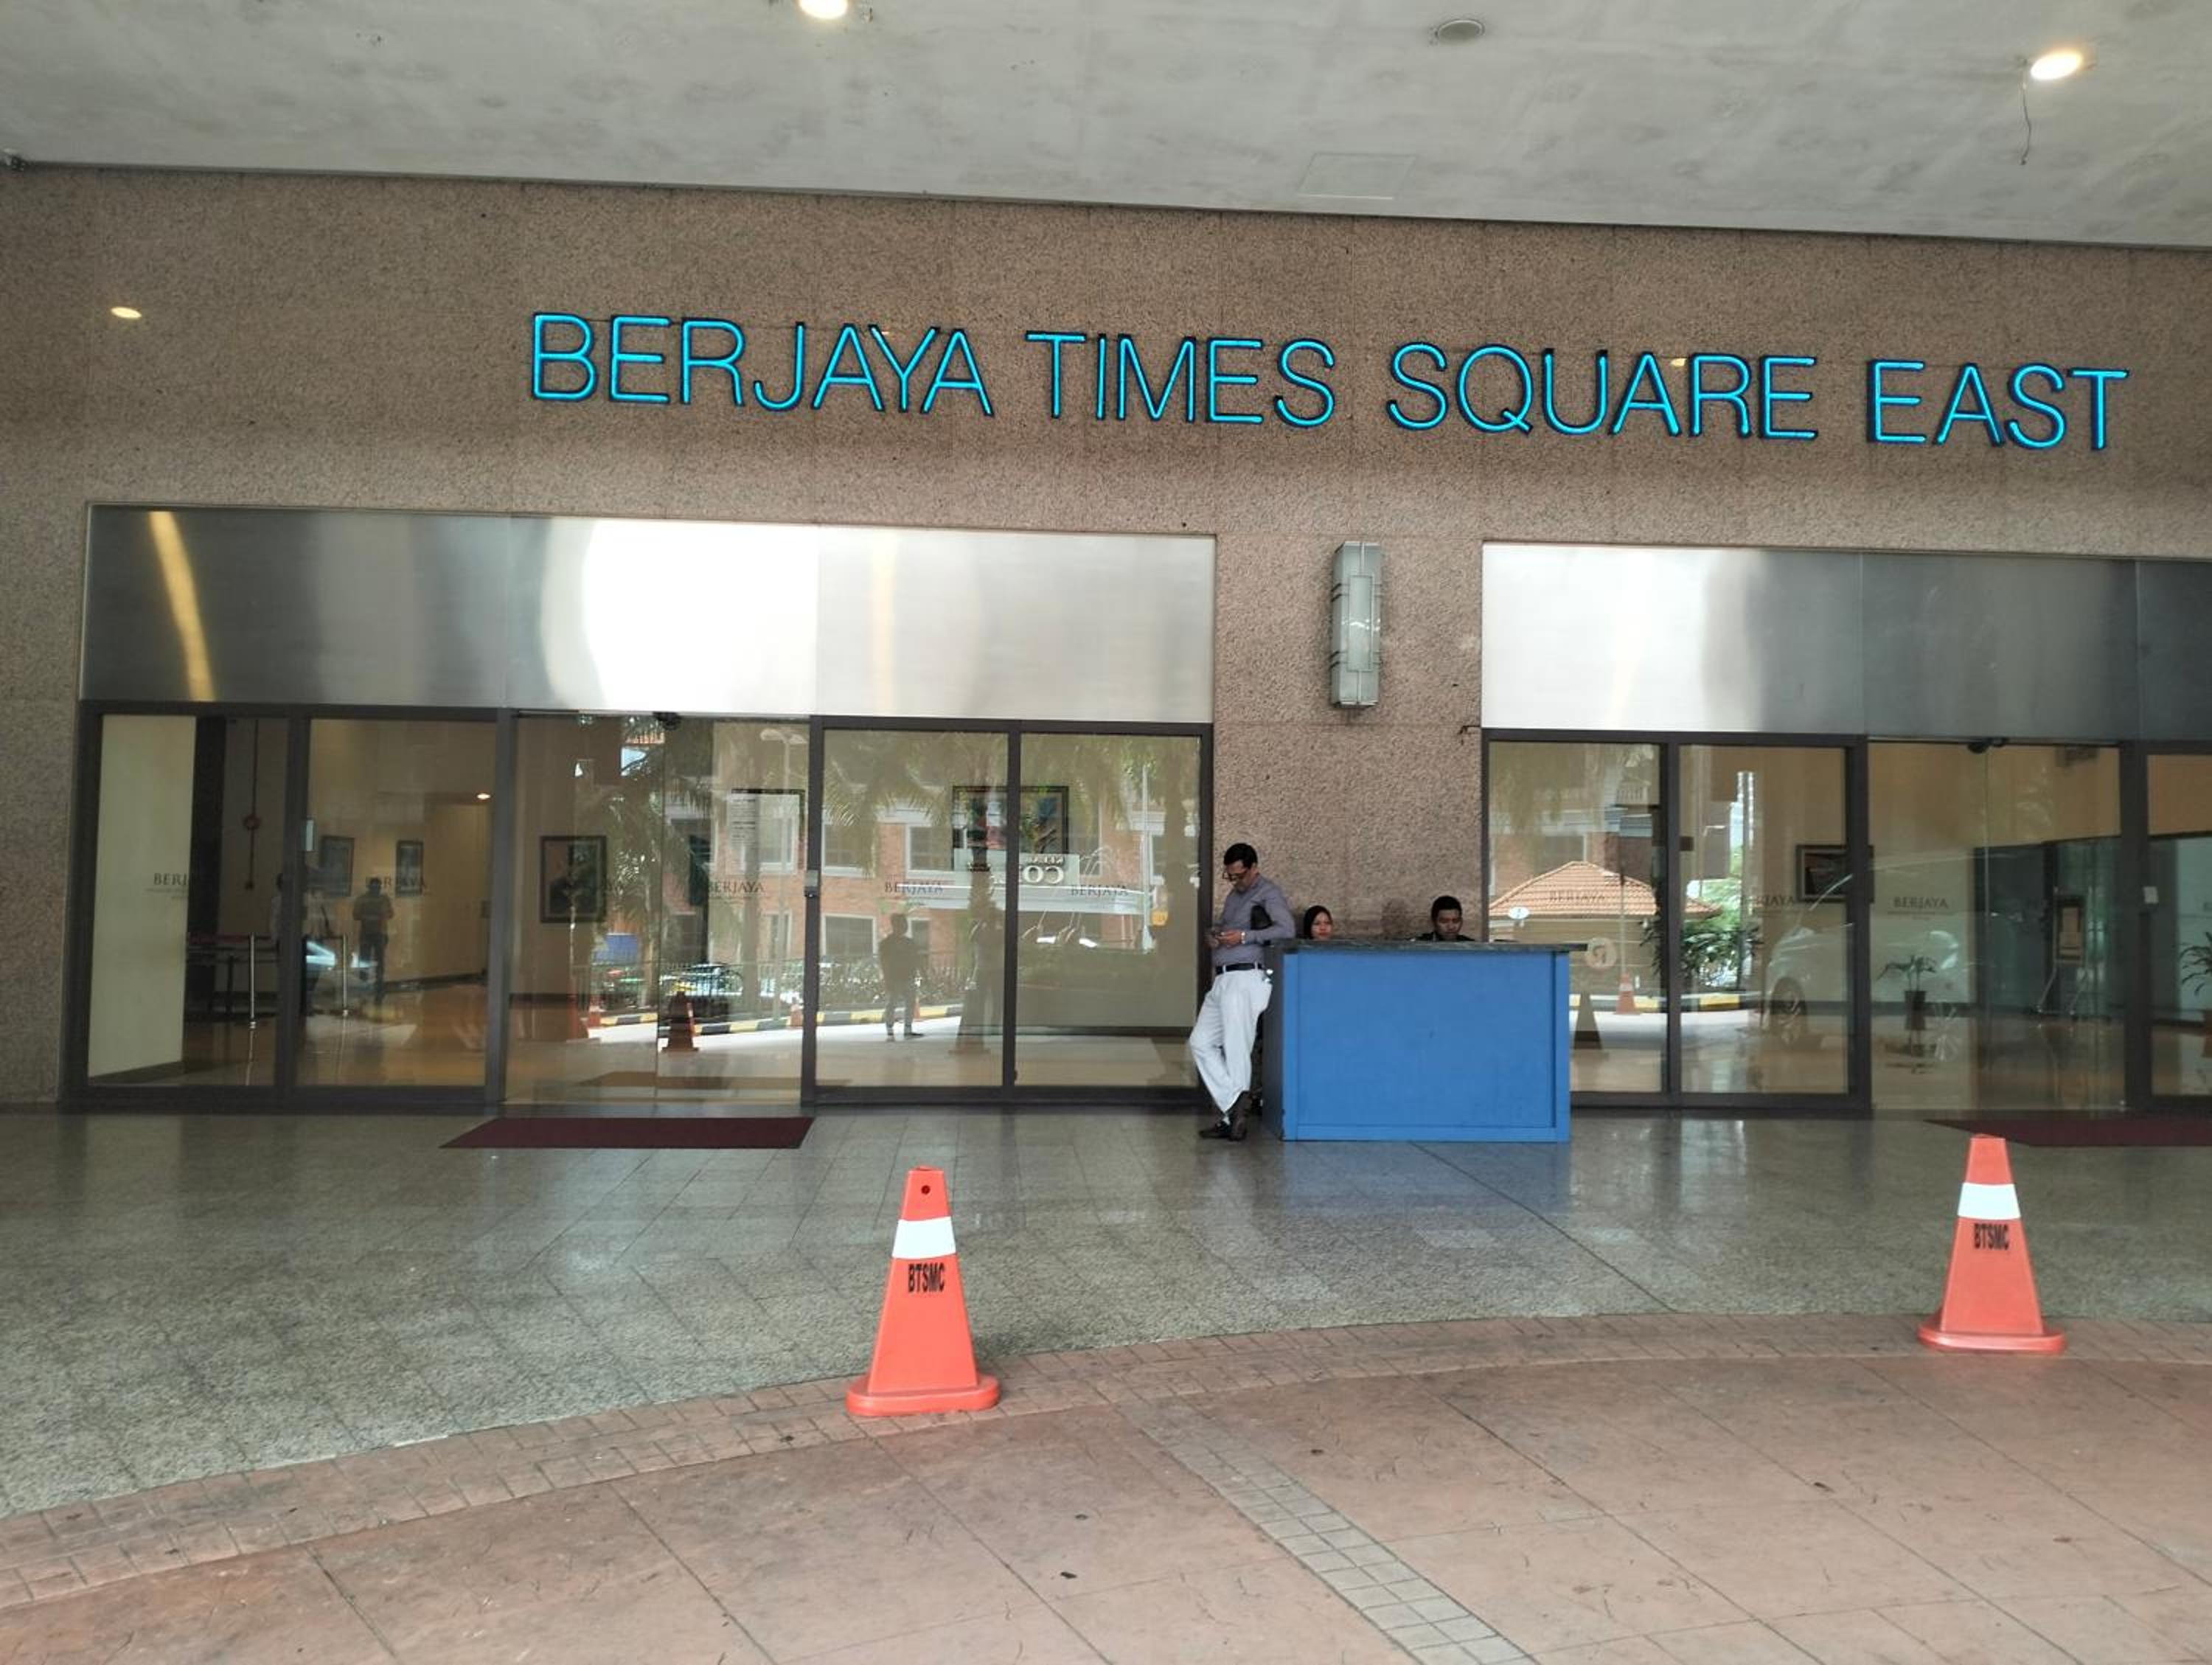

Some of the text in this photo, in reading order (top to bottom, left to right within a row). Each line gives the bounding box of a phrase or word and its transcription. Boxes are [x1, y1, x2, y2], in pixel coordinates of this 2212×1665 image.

[532, 313, 2128, 450] BERJAYA TIMES SQUARE EAST
[908, 1262, 945, 1293] BTSMC
